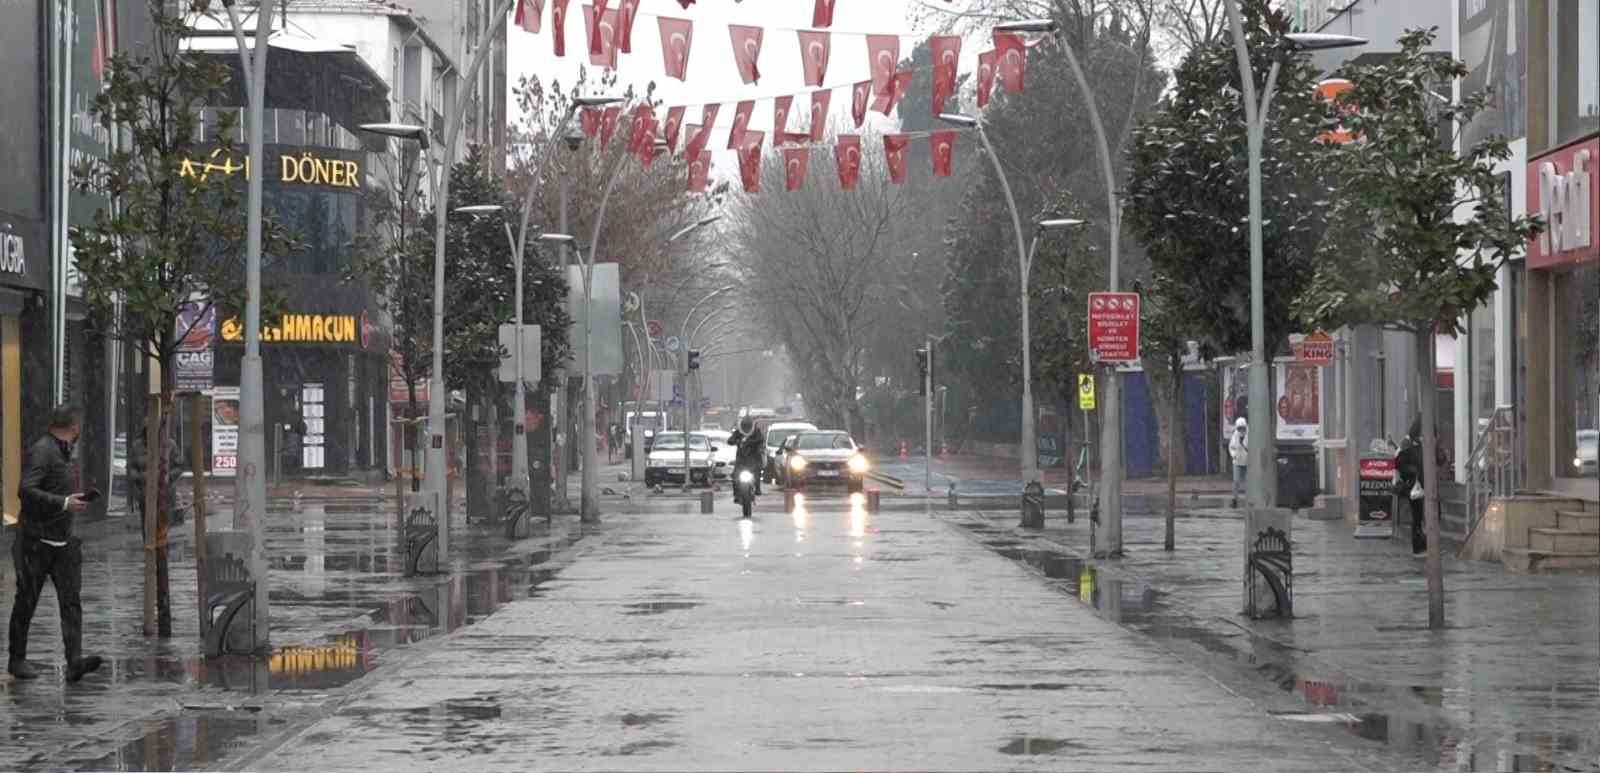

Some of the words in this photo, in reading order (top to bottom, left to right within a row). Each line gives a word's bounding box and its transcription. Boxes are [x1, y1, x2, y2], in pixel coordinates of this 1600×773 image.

[279, 152, 360, 187] DÖNER
[1304, 351, 1333, 359] KING
[215, 456, 237, 468] 250
